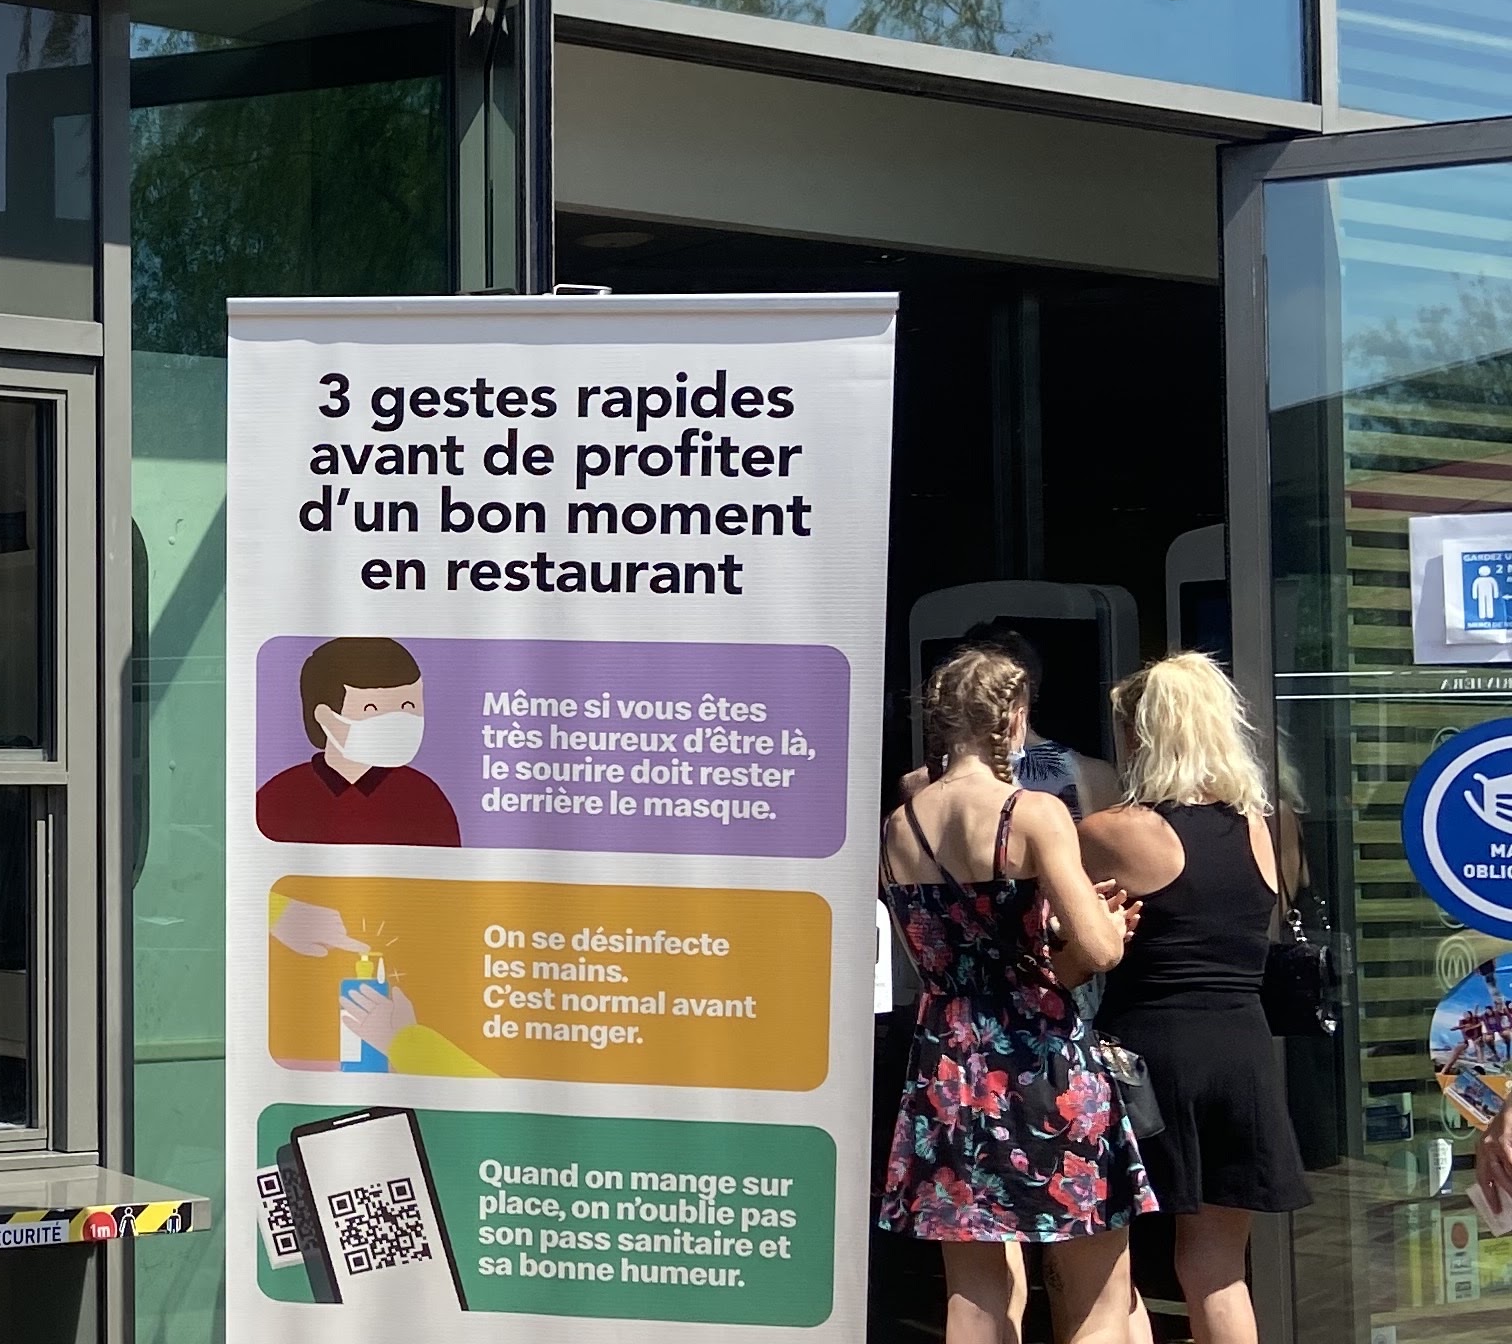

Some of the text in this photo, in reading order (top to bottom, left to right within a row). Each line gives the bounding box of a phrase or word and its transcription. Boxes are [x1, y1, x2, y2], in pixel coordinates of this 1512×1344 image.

[319, 370, 795, 432] 3 gestes rapides
[309, 429, 803, 490] avant de profiter
[299, 484, 812, 537] d’un bon moment
[361, 552, 743, 595] en restaurant
[1496, 564, 1503, 574] 2
[483, 693, 767, 723] Même si vous êtes
[482, 726, 816, 760] très heureux d’être là,
[483, 756, 795, 788] le sourire doit rester
[481, 788, 777, 825] derrière le masque.
[483, 924, 730, 956] On se désinfecte
[484, 956, 628, 984] les mains.
[483, 984, 757, 1018] C’est normal avant
[483, 1016, 643, 1050] de manger.
[478, 1159, 793, 1200] Quand on mange sur
[479, 1190, 796, 1233] place, on n’oublie pas
[478, 1224, 791, 1259] son pass sanitaire et
[478, 1256, 745, 1289] sa bonne humeur.
